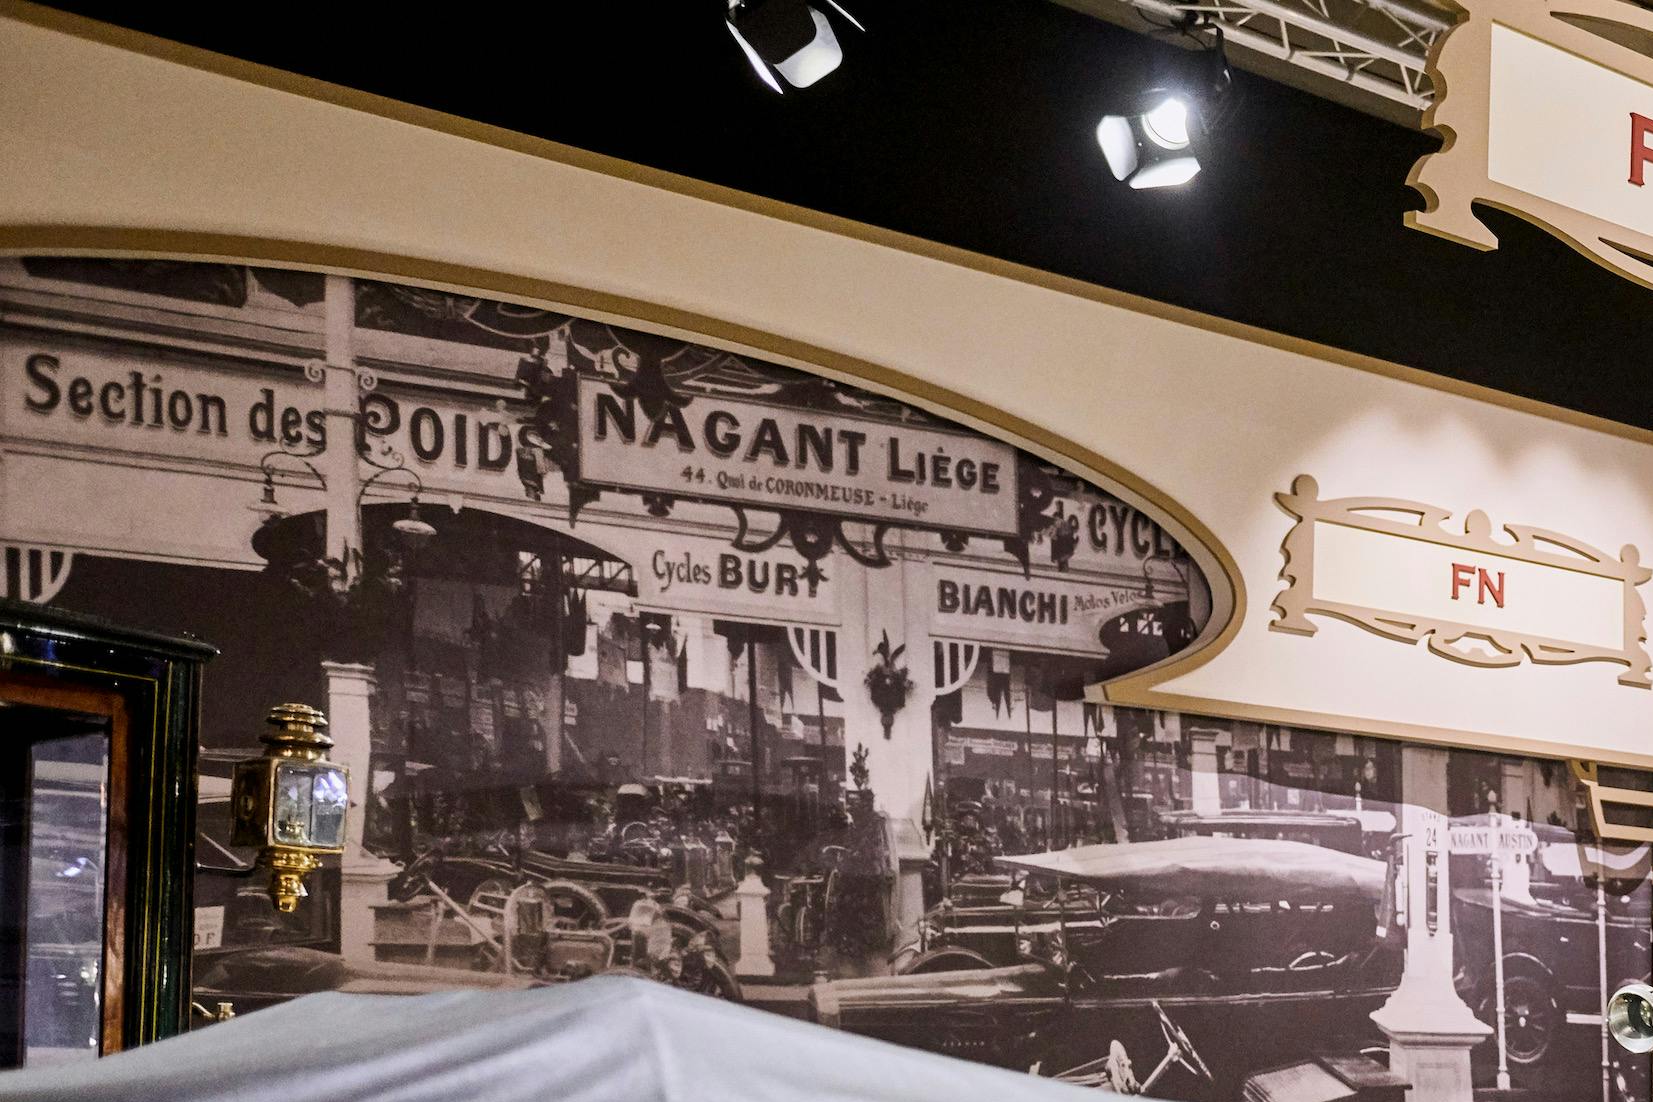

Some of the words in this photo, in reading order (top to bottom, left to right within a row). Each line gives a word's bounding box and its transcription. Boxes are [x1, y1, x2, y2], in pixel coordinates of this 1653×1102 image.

[24, 351, 229, 438] Section
[248, 386, 328, 449] des
[594, 392, 867, 476] NAGANT
[748, 475, 763, 491] de
[764, 476, 875, 506] CORONMEUSE
[652, 550, 712, 593] Cycles
[1451, 562, 1505, 609] FN
[938, 579, 1068, 625] BIANCHI
[1425, 827, 1437, 848] 24
[1451, 832, 1488, 849] NAGANT
[1499, 832, 1533, 850] AUSTIN
